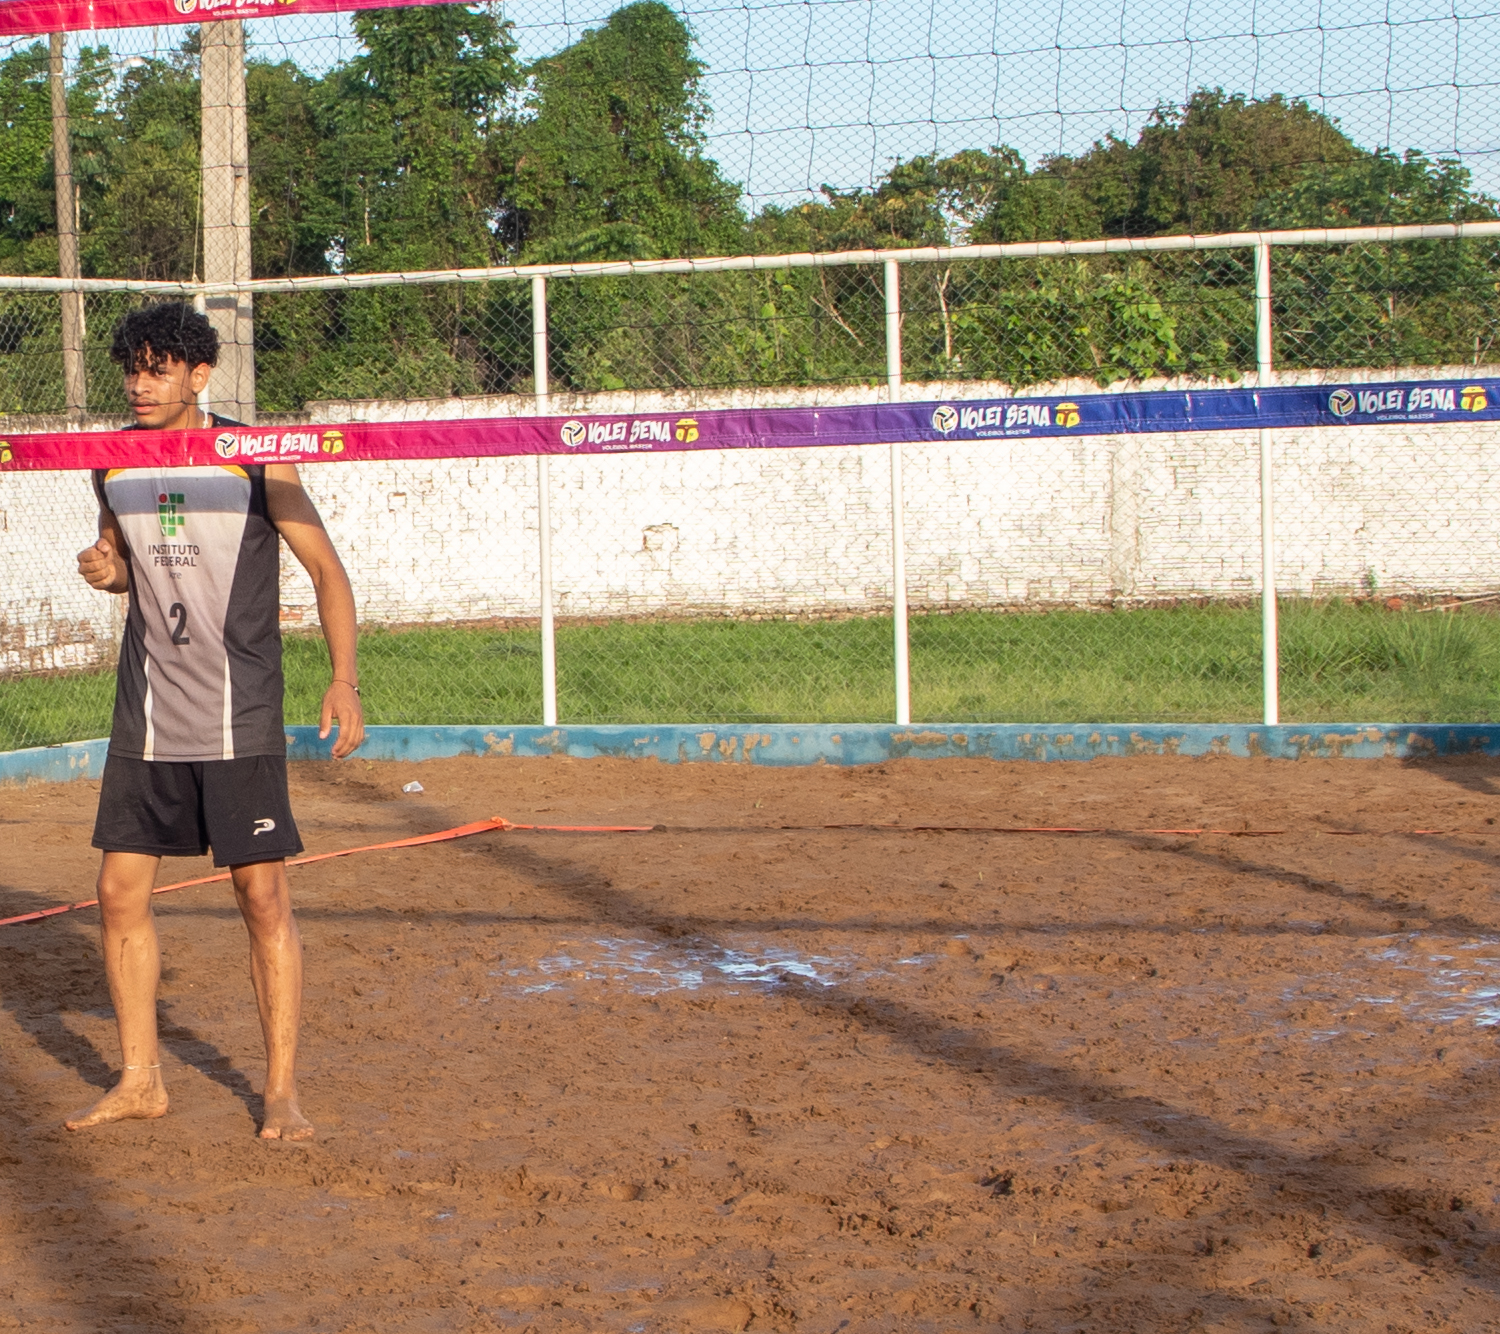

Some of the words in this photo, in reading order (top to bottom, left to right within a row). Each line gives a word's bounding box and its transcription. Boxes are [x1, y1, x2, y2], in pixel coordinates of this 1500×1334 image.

[1406, 387, 1456, 412] SENA
[1004, 404, 1050, 428] SENA
[279, 432, 318, 455] SENA
[629, 420, 671, 443] SENA
[169, 602, 190, 646] 2
